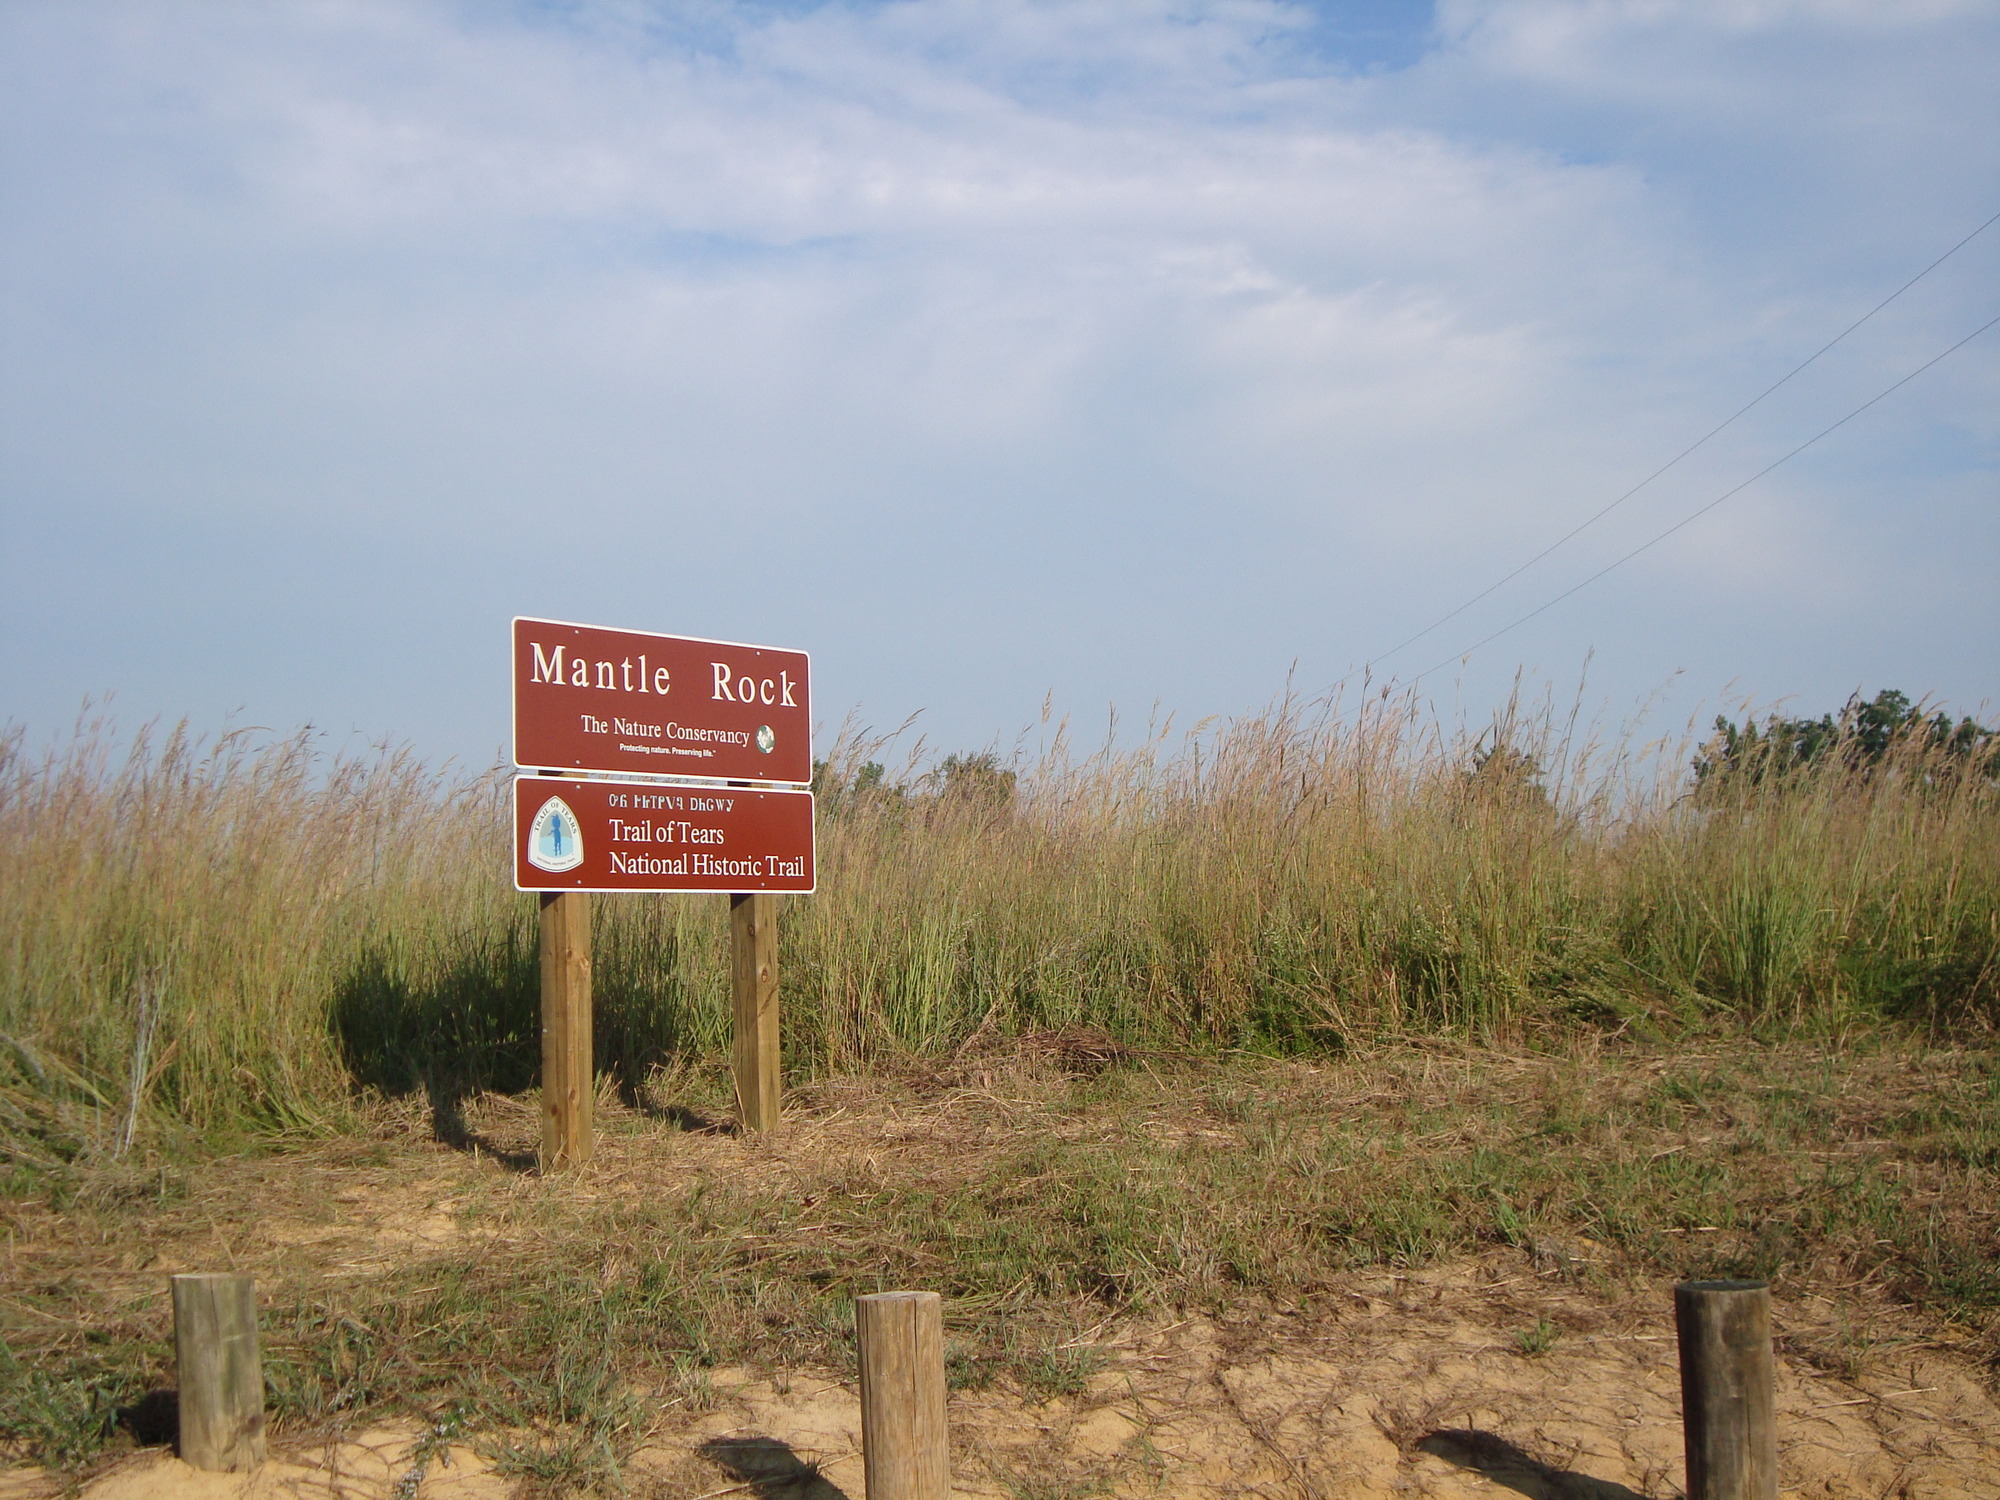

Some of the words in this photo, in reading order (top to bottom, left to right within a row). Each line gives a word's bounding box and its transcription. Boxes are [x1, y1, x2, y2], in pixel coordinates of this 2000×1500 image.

[529, 642, 671, 695] Mantle
[710, 662, 798, 707] Rock
[581, 714, 608, 734] The
[613, 717, 661, 738] Nature
[666, 722, 750, 748] Conservancy
[619, 743, 650, 754] Protecting
[651, 746, 671, 754] nature.
[672, 747, 702, 758] Preserving
[534, 808, 550, 832] TRAIL
[561, 807, 577, 834] TEARS
[608, 818, 651, 843] Trail
[655, 820, 676, 843] of
[677, 821, 724, 845] Tears
[609, 851, 688, 875] National
[692, 854, 762, 877] Historic
[765, 855, 805, 878] Trail
